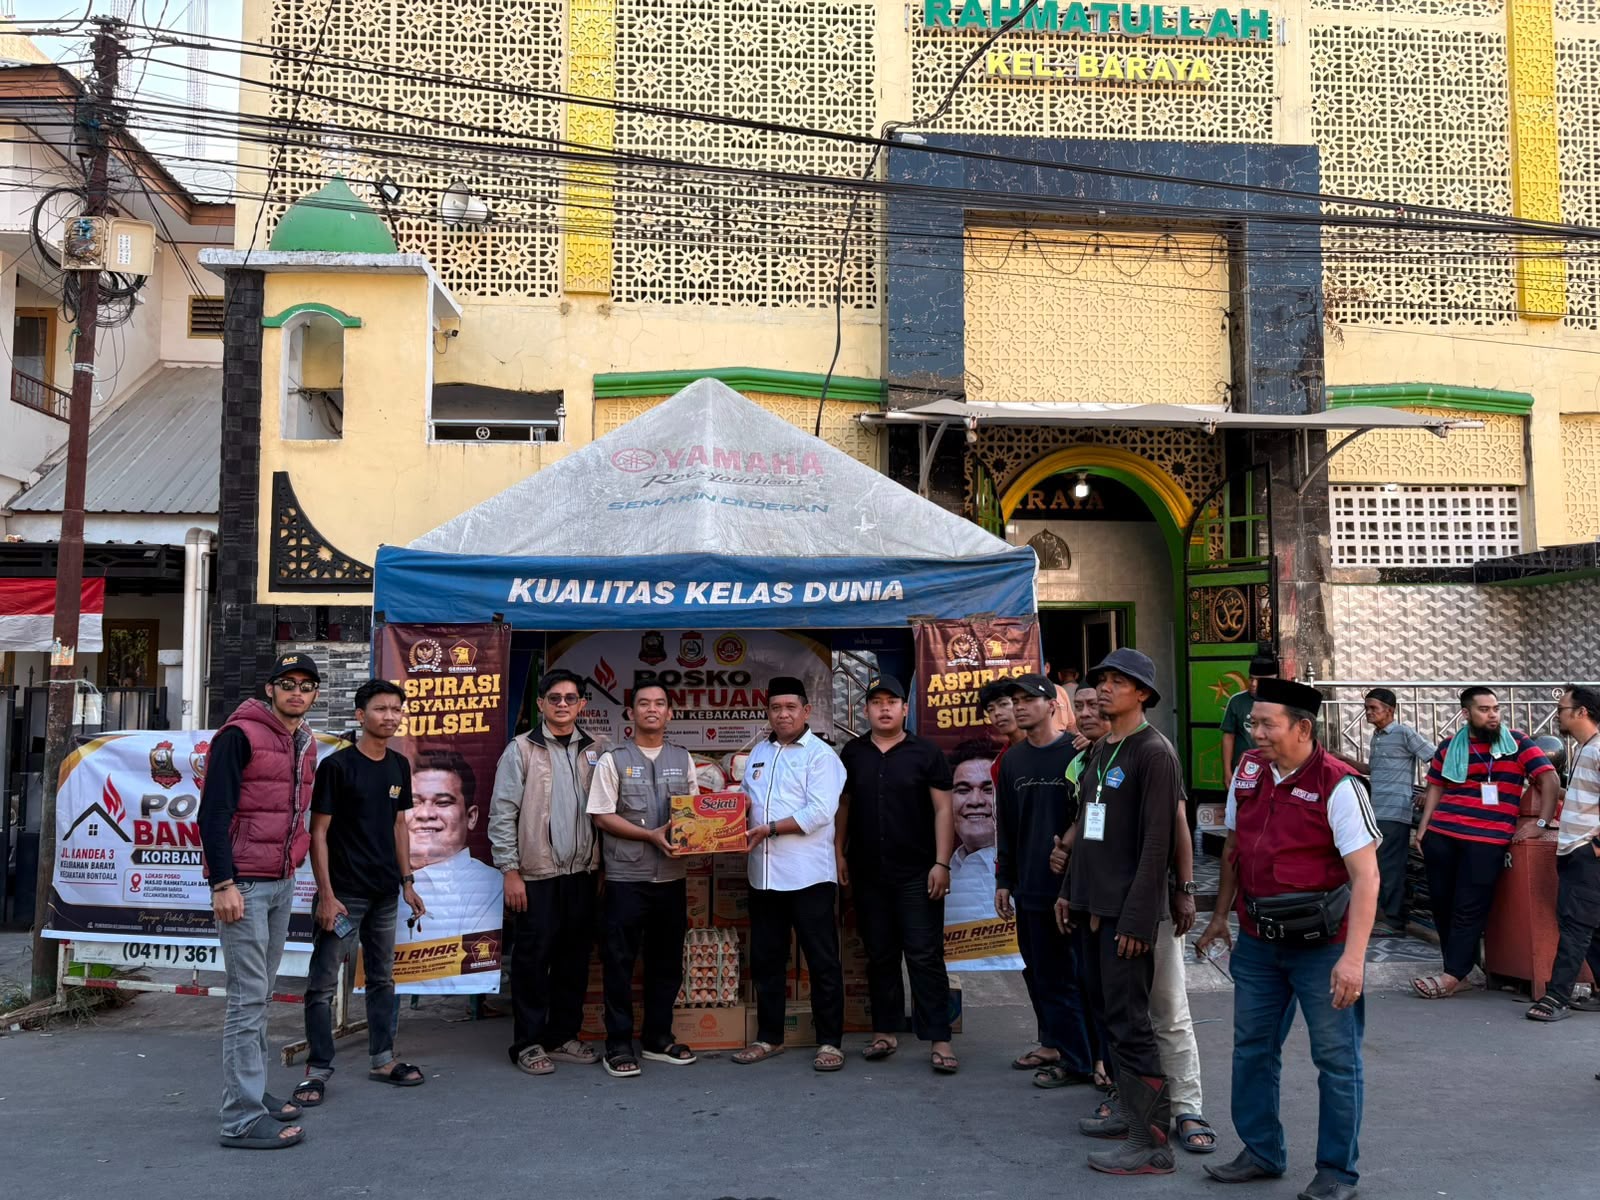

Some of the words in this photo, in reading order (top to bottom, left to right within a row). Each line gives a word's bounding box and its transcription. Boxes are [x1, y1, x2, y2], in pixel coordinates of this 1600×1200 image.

[923, 0, 1269, 40] RAHMATULLAH
[986, 52, 1064, 78] KEL.
[1077, 54, 1211, 82] BARAYA
[661, 445, 824, 475] YAMAHA
[607, 492, 716, 511] SEMAKIN
[721, 496, 744, 506] DI
[749, 500, 829, 513] DEPAN
[1016, 489, 1104, 510] RAYA
[507, 578, 676, 605] KUALITAS
[684, 581, 793, 605] KELAS
[802, 580, 903, 604] DUNIA
[390, 674, 501, 698] SPIRASI
[634, 669, 752, 687] POSKO
[401, 695, 501, 714] ASYARAKAT
[623, 688, 769, 708] NTUAN
[688, 711, 767, 720] KEBAKARAN
[700, 797, 738, 810] Sejati
[108, 849, 115, 859] 3
[141, 851, 200, 864] KORBAN
[91, 862, 116, 870] BARAYA
[944, 929, 968, 942] NDI
[971, 922, 1016, 938] AMAR
[123, 942, 179, 964] (0411)
[408, 943, 460, 960] AMAR
